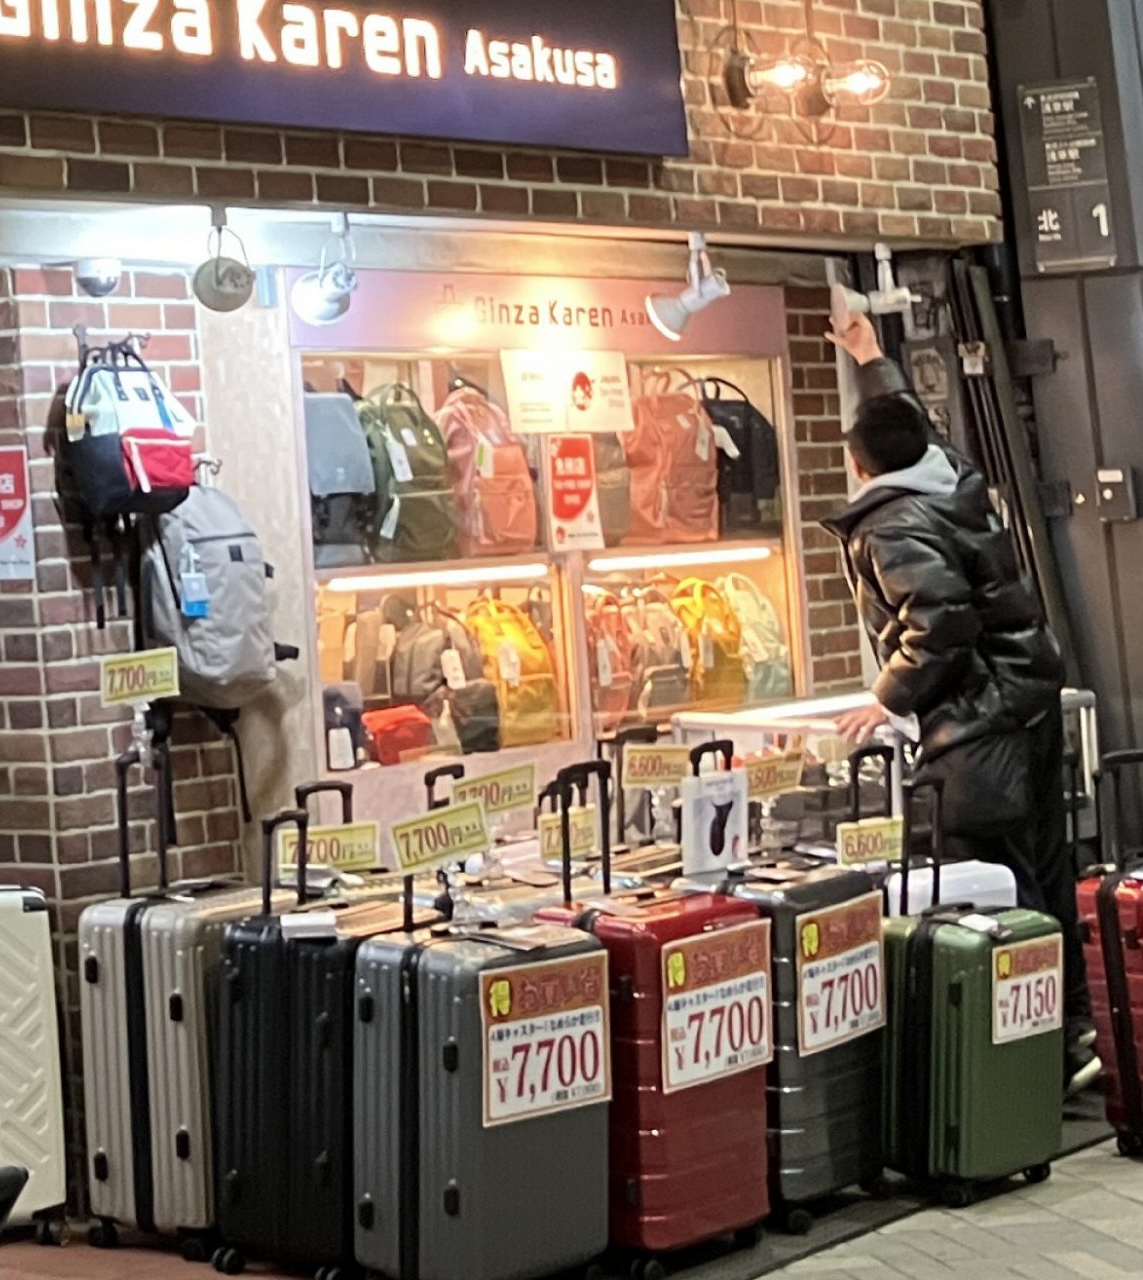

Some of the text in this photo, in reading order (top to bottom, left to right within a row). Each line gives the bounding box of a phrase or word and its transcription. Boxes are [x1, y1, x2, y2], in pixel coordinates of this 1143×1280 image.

[464, 28, 617, 89] Asakusa
[1092, 203, 1108, 236] 1
[474, 296, 540, 325] Ginza
[549, 300, 613, 327] Karen
